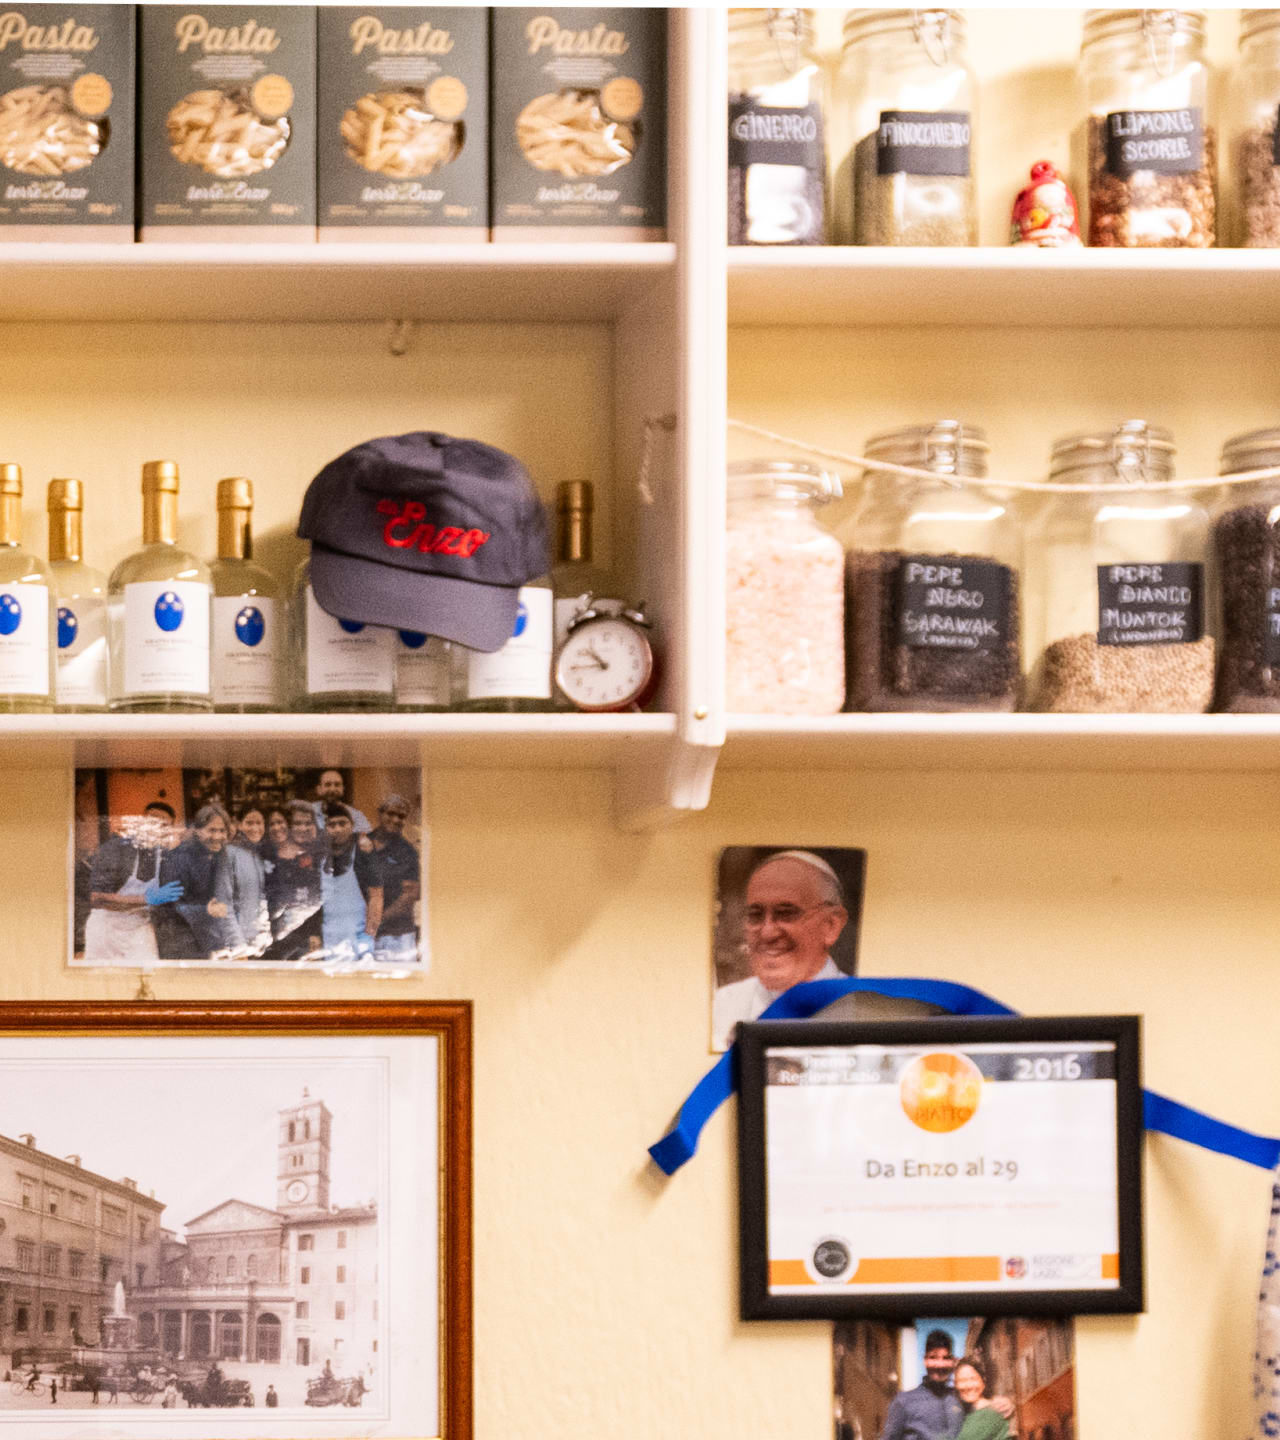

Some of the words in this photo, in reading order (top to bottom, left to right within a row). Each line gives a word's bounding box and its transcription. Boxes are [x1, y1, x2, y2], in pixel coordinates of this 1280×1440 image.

[175, 14, 281, 52] Pasta
[350, 16, 455, 55] Pasta
[527, 16, 630, 55] Pasta
[382, 501, 491, 558] Enzo
[906, 562, 964, 586] PEPE
[1109, 566, 1163, 584] PEPE
[903, 611, 1000, 637] SARAWAK
[1102, 608, 1187, 629] MUNTOK
[1016, 1054, 1082, 1080] 2016
[865, 1159, 896, 1179] Da
[903, 1159, 959, 1179] Enzo
[966, 1157, 984, 1178] al
[992, 1160, 1019, 1182] 29
